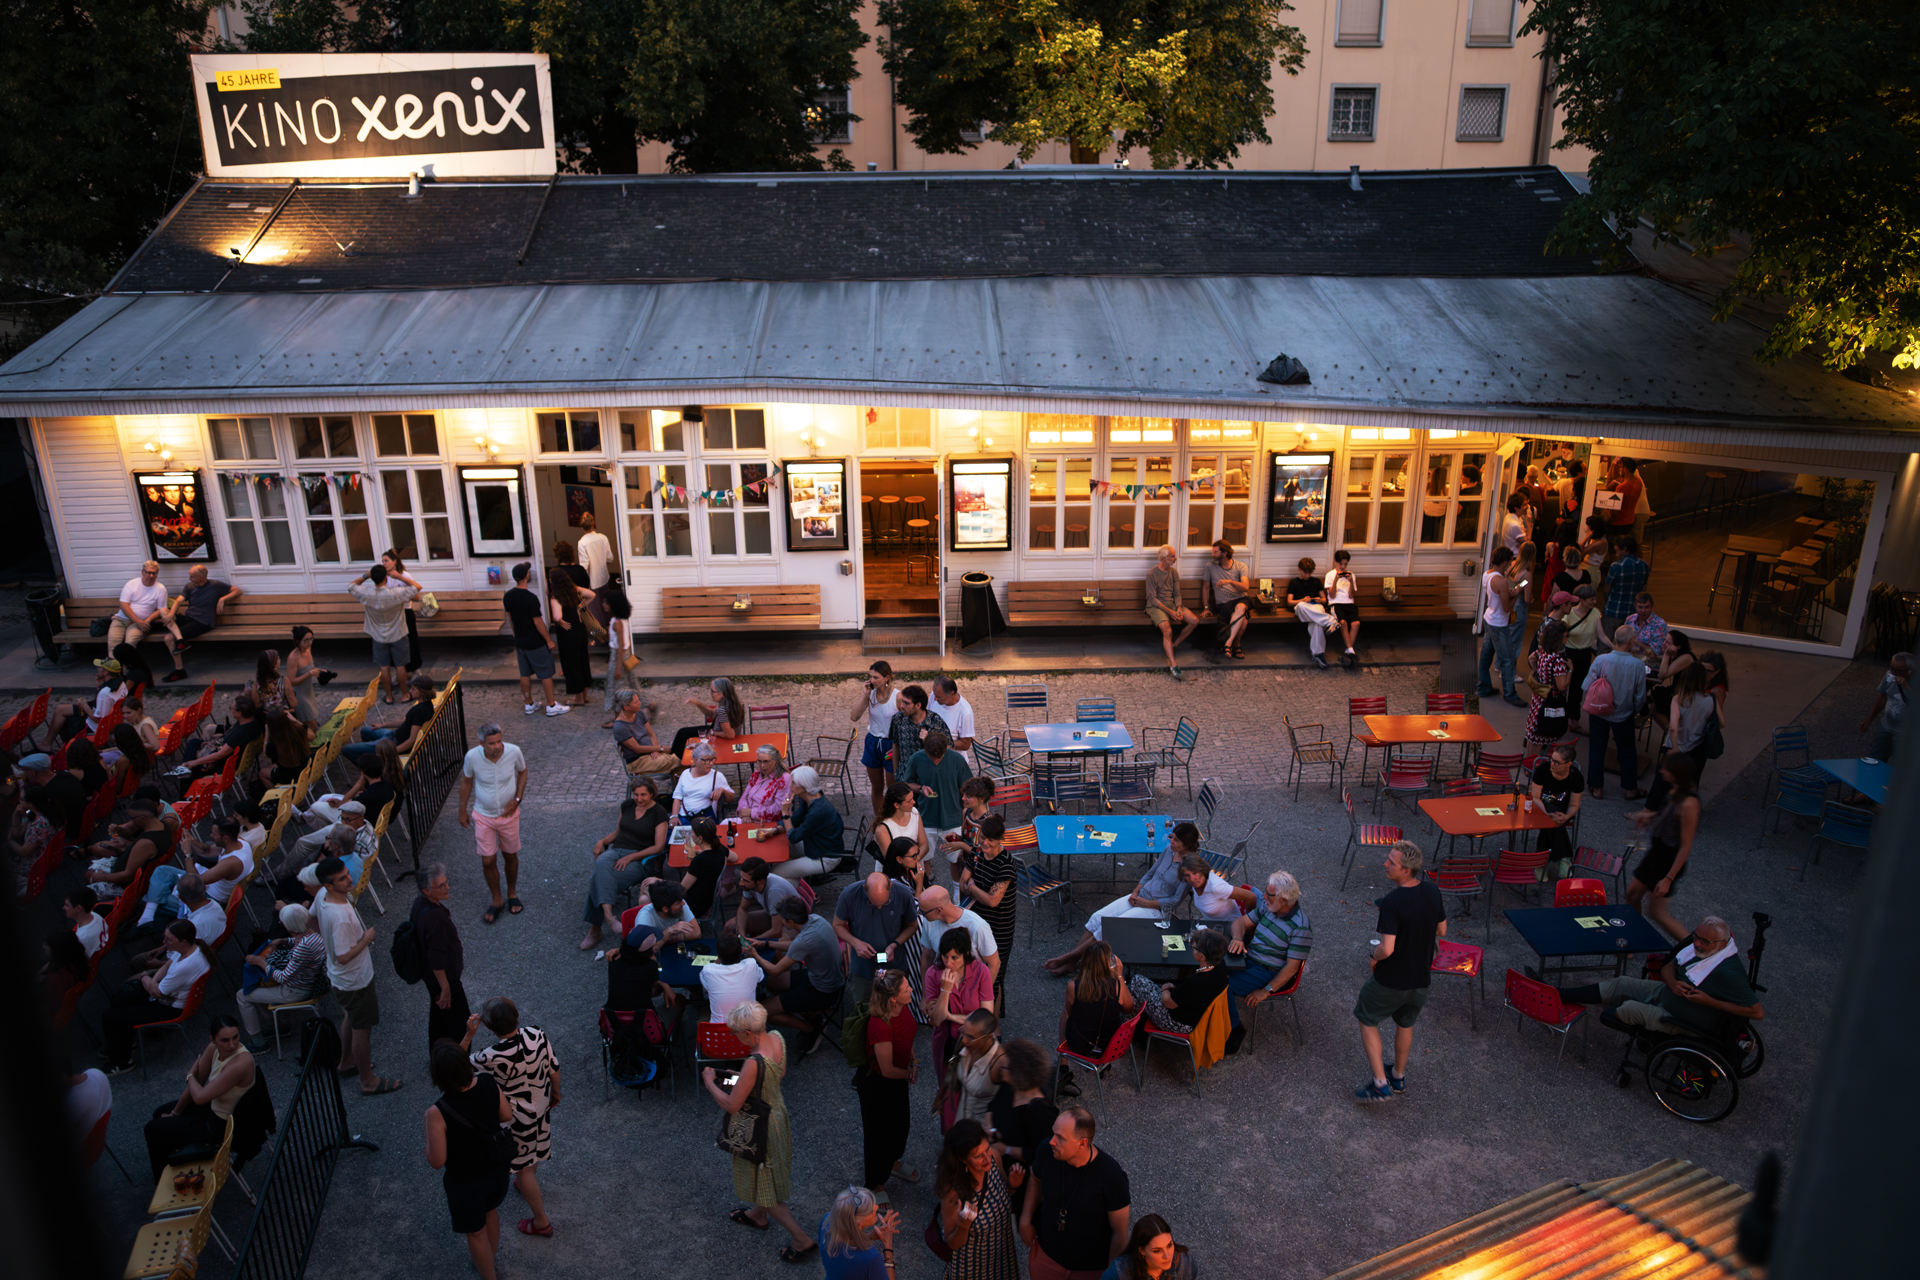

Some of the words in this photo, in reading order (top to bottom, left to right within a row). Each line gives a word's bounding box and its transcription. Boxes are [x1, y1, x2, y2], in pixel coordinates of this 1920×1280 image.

[220, 74, 235, 88] 45
[237, 72, 276, 87] JAHRE
[222, 98, 342, 150] KINO
[351, 76, 531, 142] xenix
